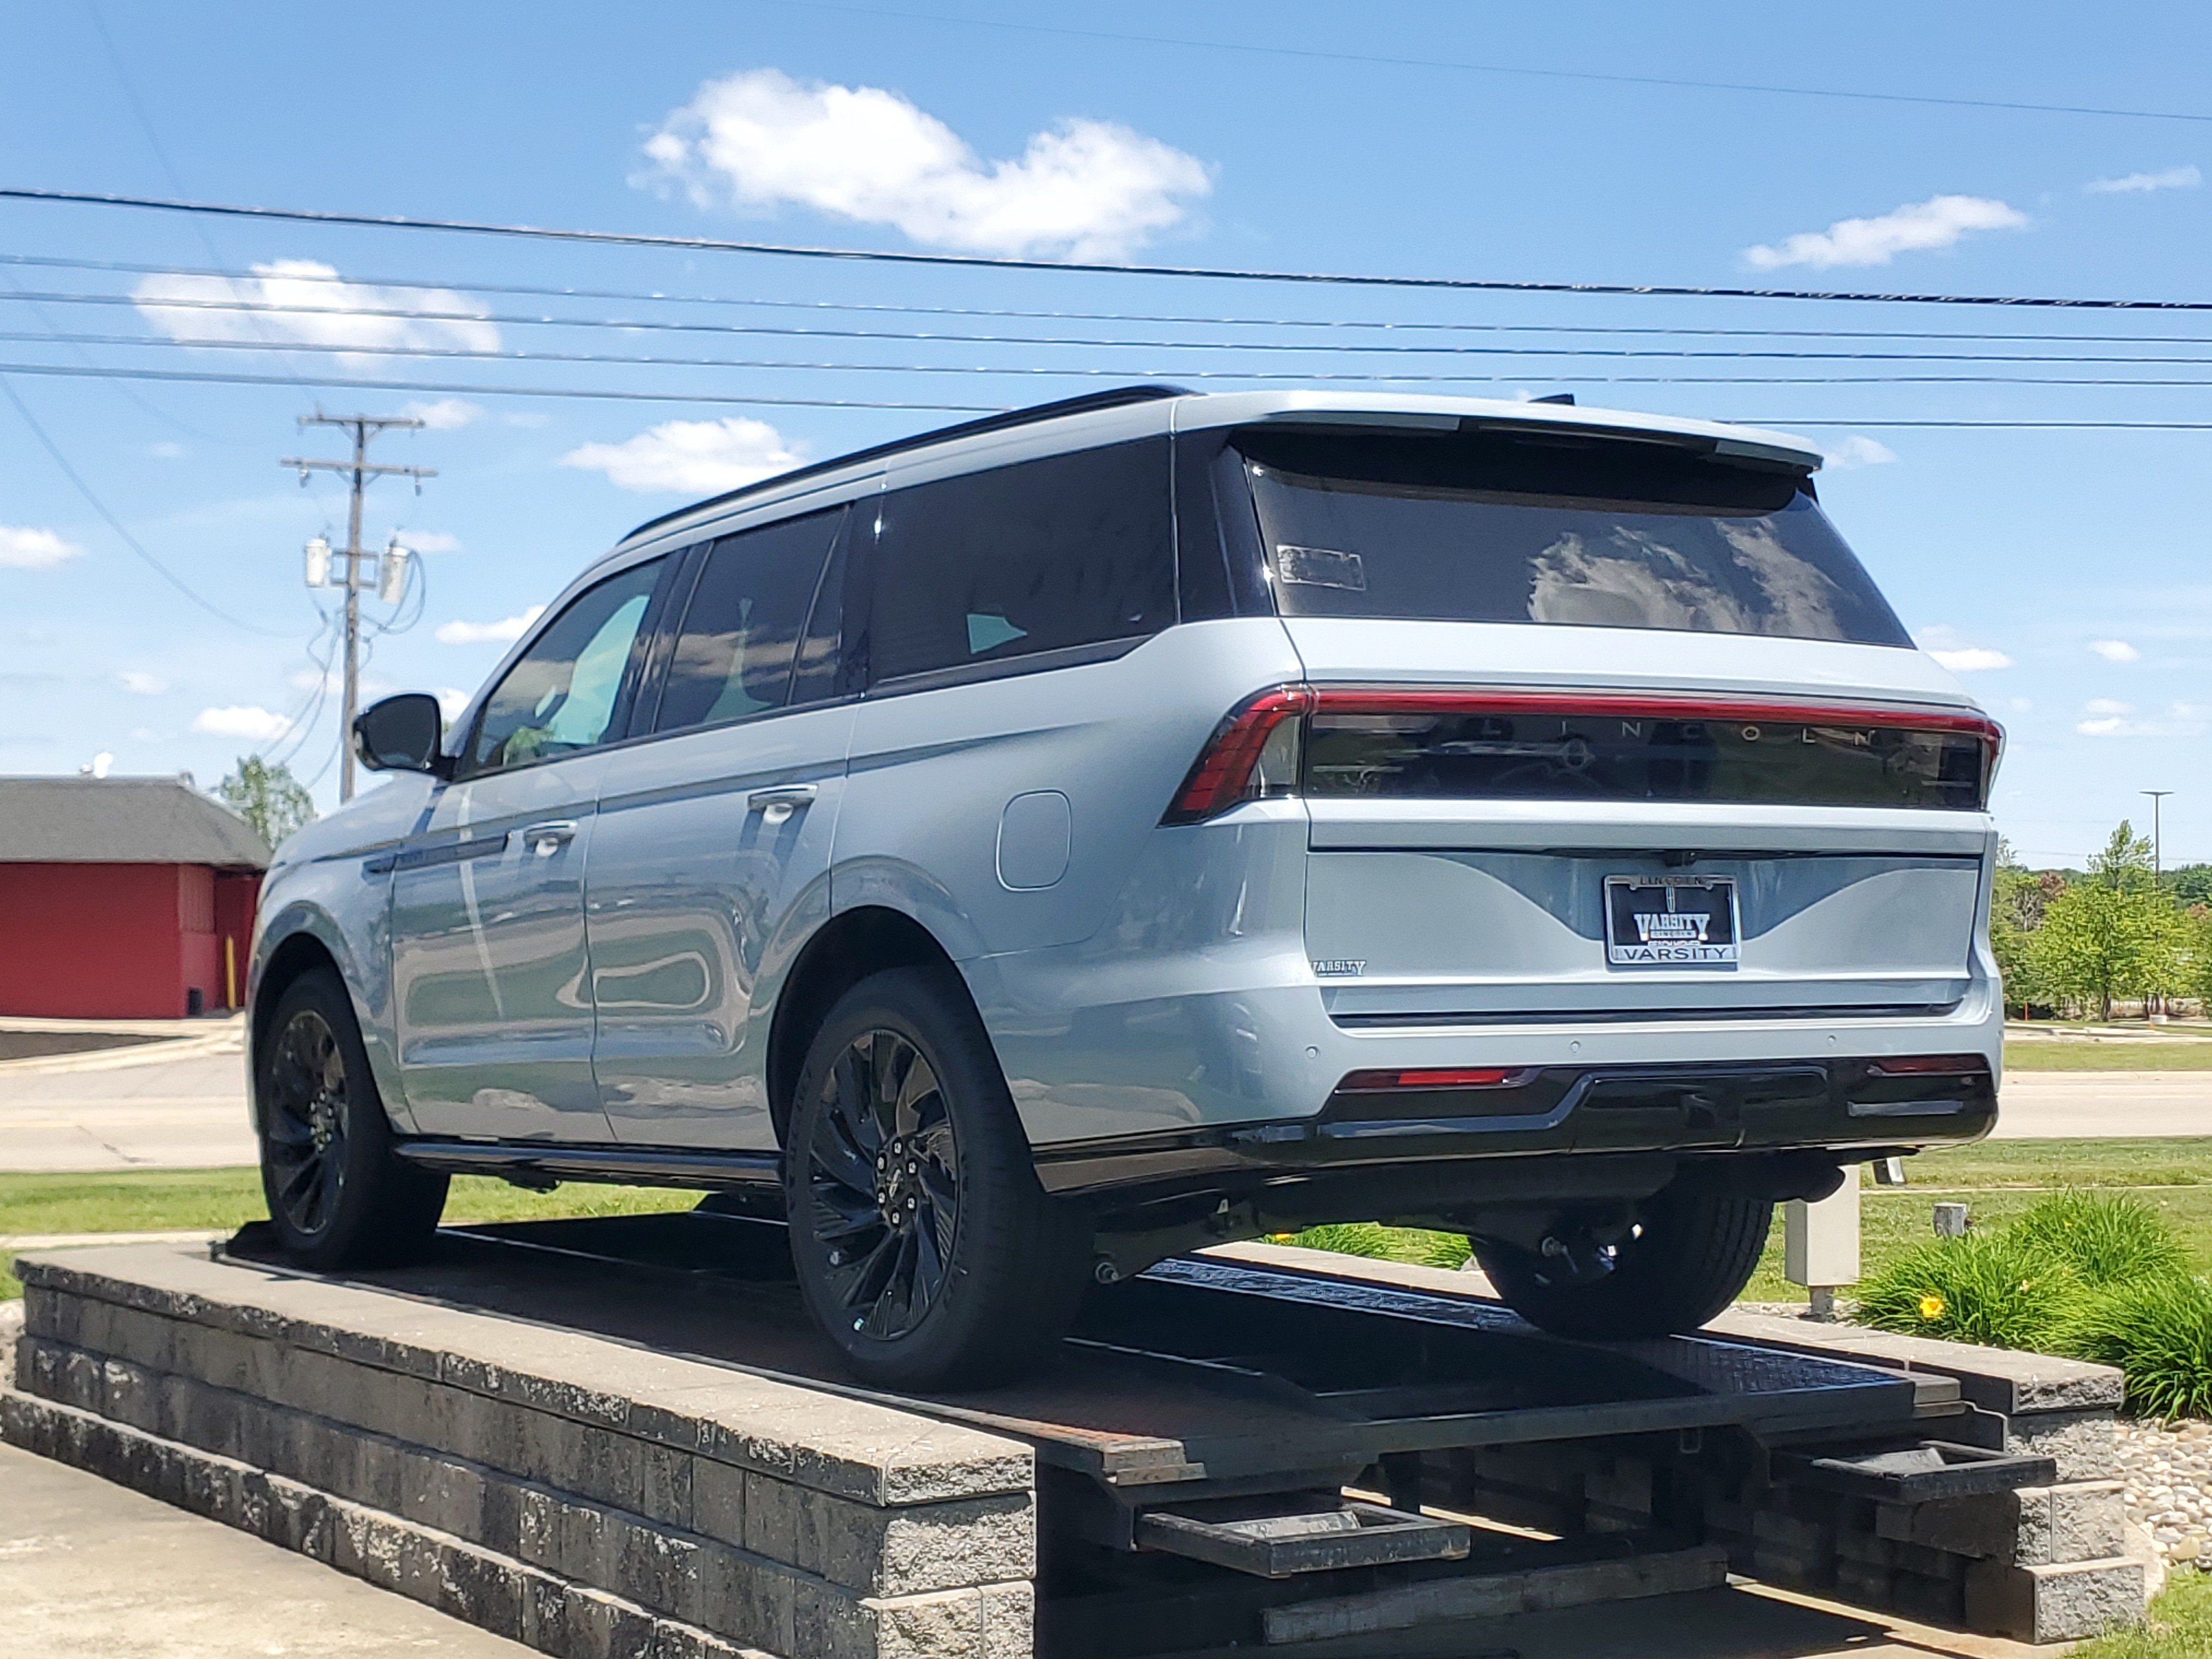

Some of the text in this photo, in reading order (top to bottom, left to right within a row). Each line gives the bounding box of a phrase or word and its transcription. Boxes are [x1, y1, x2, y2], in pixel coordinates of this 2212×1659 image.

[1483, 719, 1876, 746] LINCOLN
[1633, 913, 1710, 941] VARSITY
[1623, 947, 1728, 960] VARSITY
[1310, 960, 1366, 975] VARSITY
